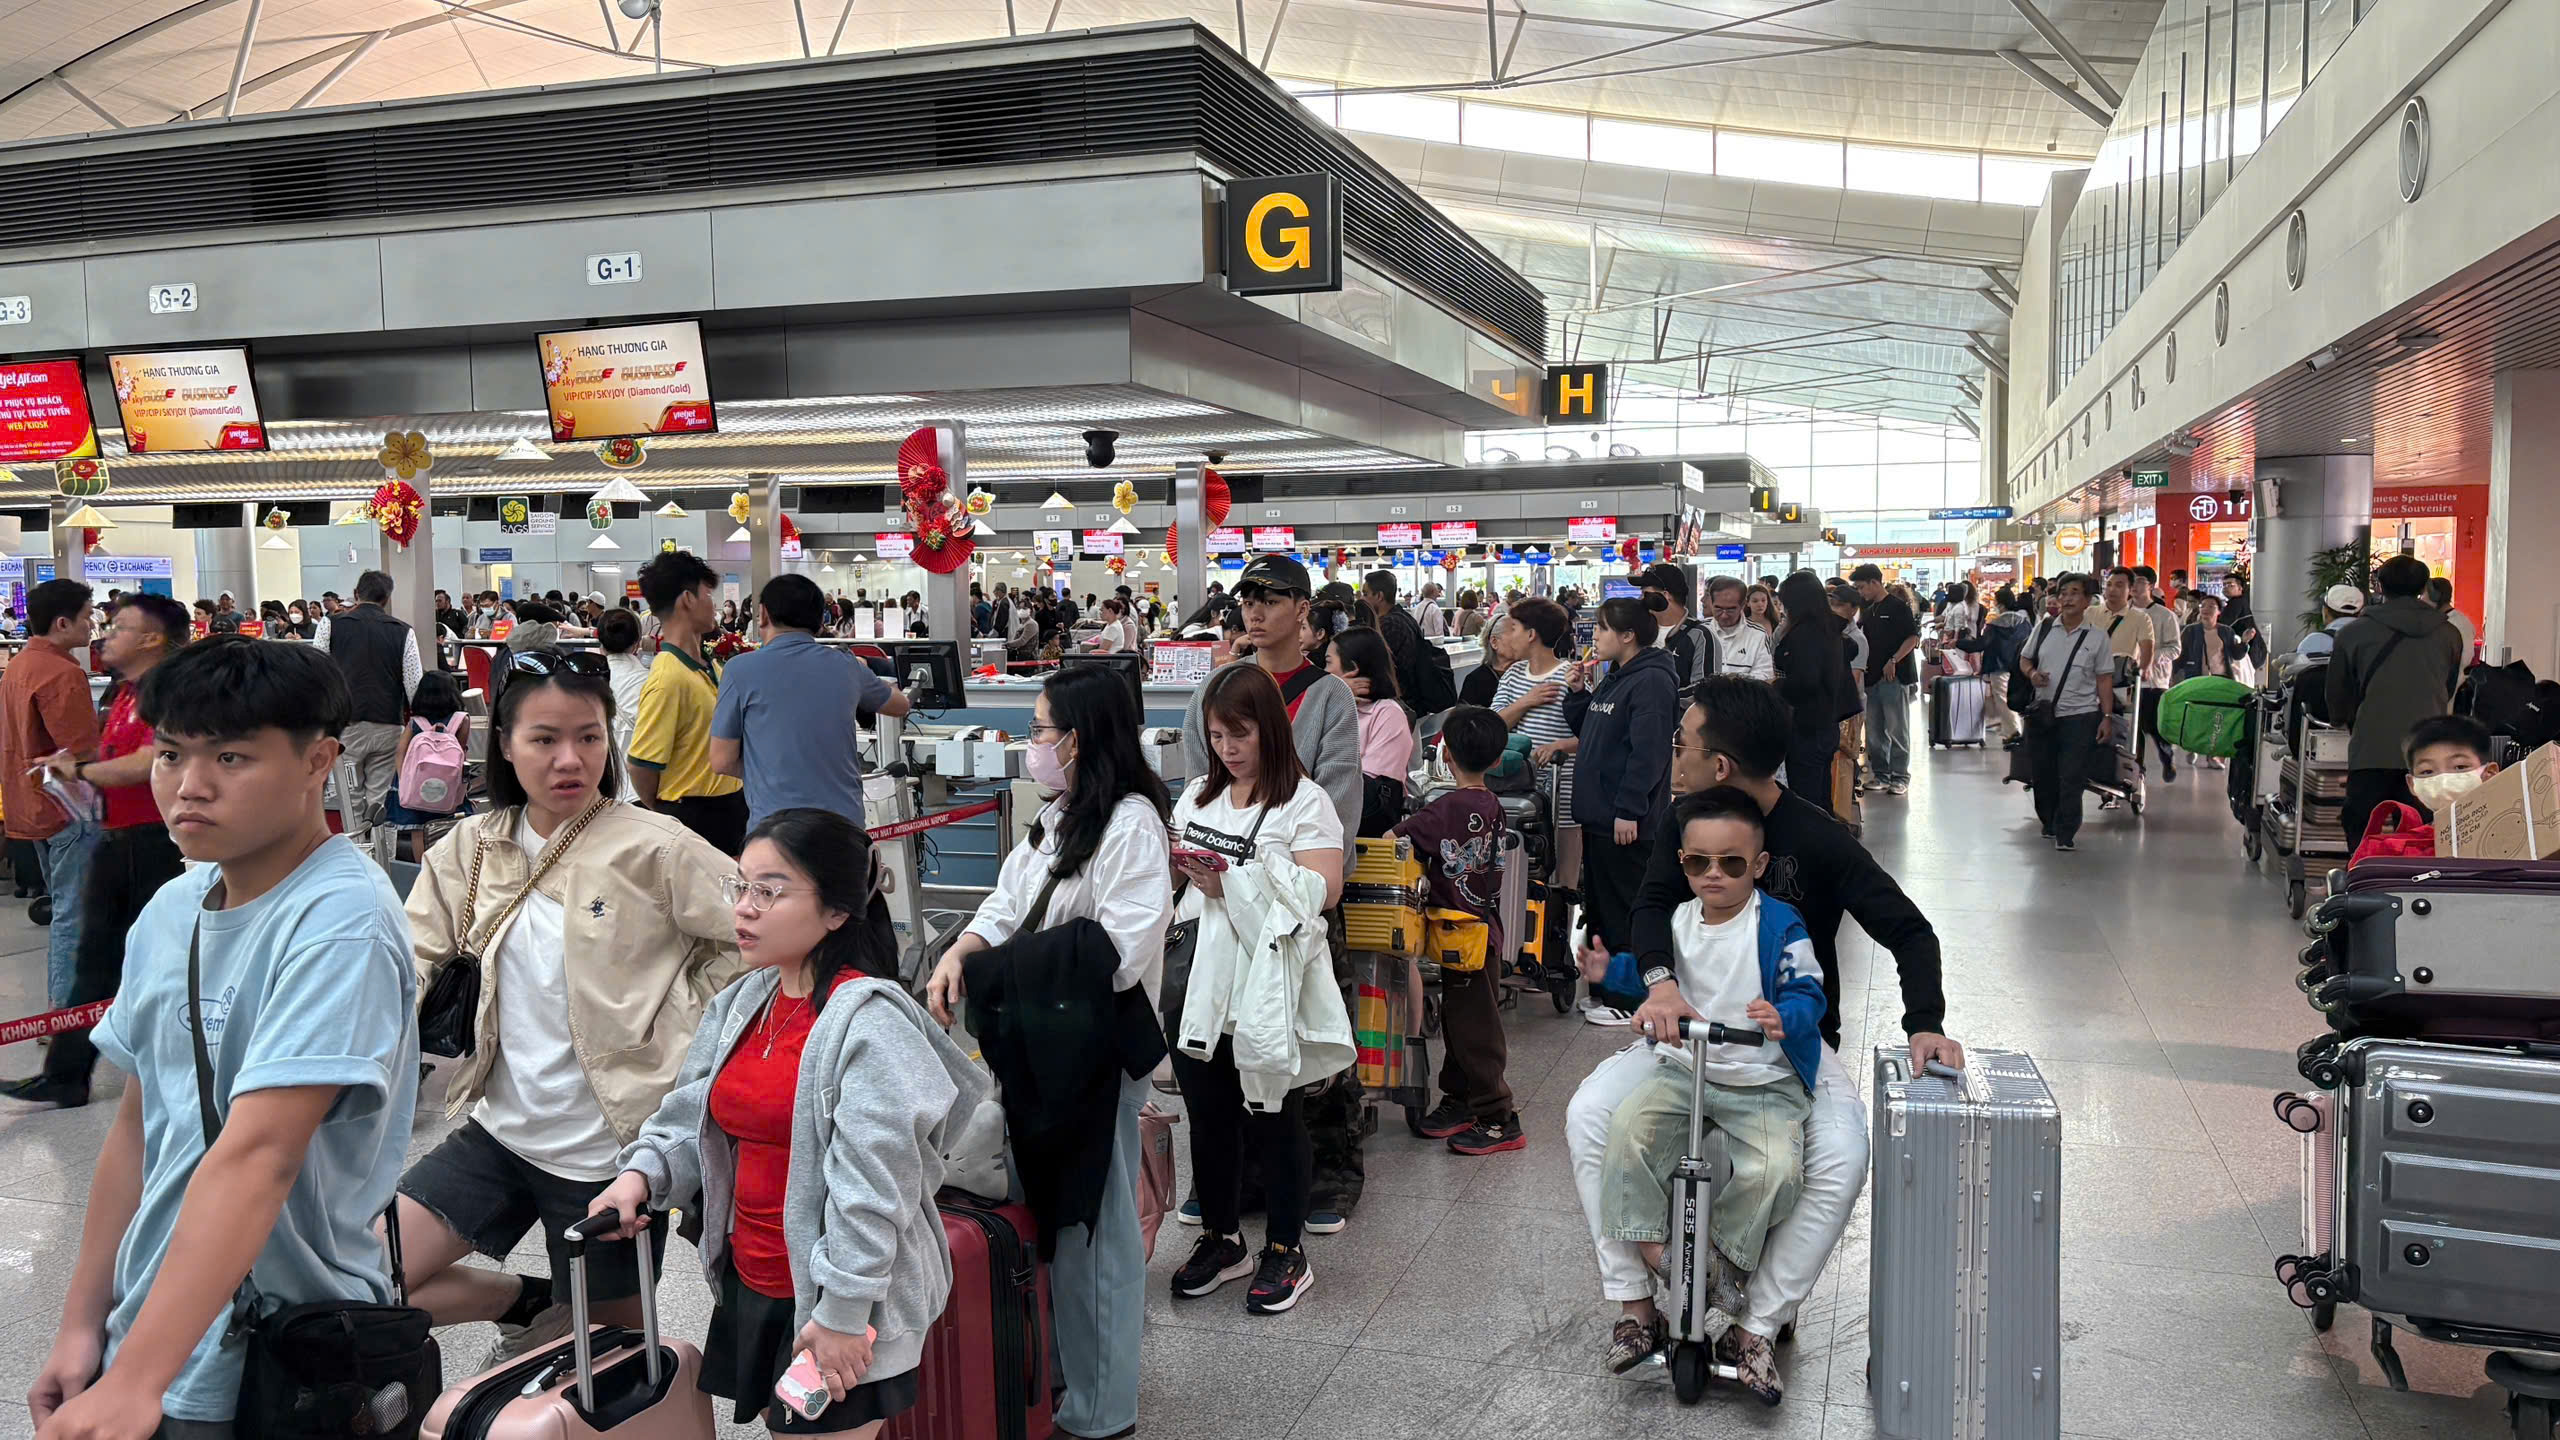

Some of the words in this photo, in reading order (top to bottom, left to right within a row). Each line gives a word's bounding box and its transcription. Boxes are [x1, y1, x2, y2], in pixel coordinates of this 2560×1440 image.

[1245, 192, 1311, 273] G
[597, 257, 632, 280] G-1
[159, 288, 192, 308] G-2
[577, 345, 605, 358] HẠNG
[607, 341, 648, 355] THƯƠNG
[651, 340, 668, 351] GIA
[143, 367, 166, 379] HẠNG
[168, 365, 204, 376] THƯƠNG
[205, 364, 220, 375] GIA
[628, 383, 691, 398] (Diamond/Gold)
[1560, 373, 1593, 415] H
[37, 394, 62, 405] KHÁCH
[2138, 474, 2157, 485] EXIT
[1763, 491, 1768, 509] I
[2401, 492, 2457, 503] Specialties
[1786, 504, 1797, 521] J
[2401, 504, 2453, 513] Souvenirs
[501, 524, 529, 534] SAGS
[1826, 530, 1835, 540] K
[120, 562, 153, 572] EXCHANGE
[894, 817, 930, 834] INTERNATIONAL
[1186, 826, 1207, 841] new
[1207, 834, 1252, 854] balanc
[1, 1019, 47, 1042] KHÔNG
[51, 1007, 85, 1032] QUỐC
[87, 1003, 105, 1022] TẾ
